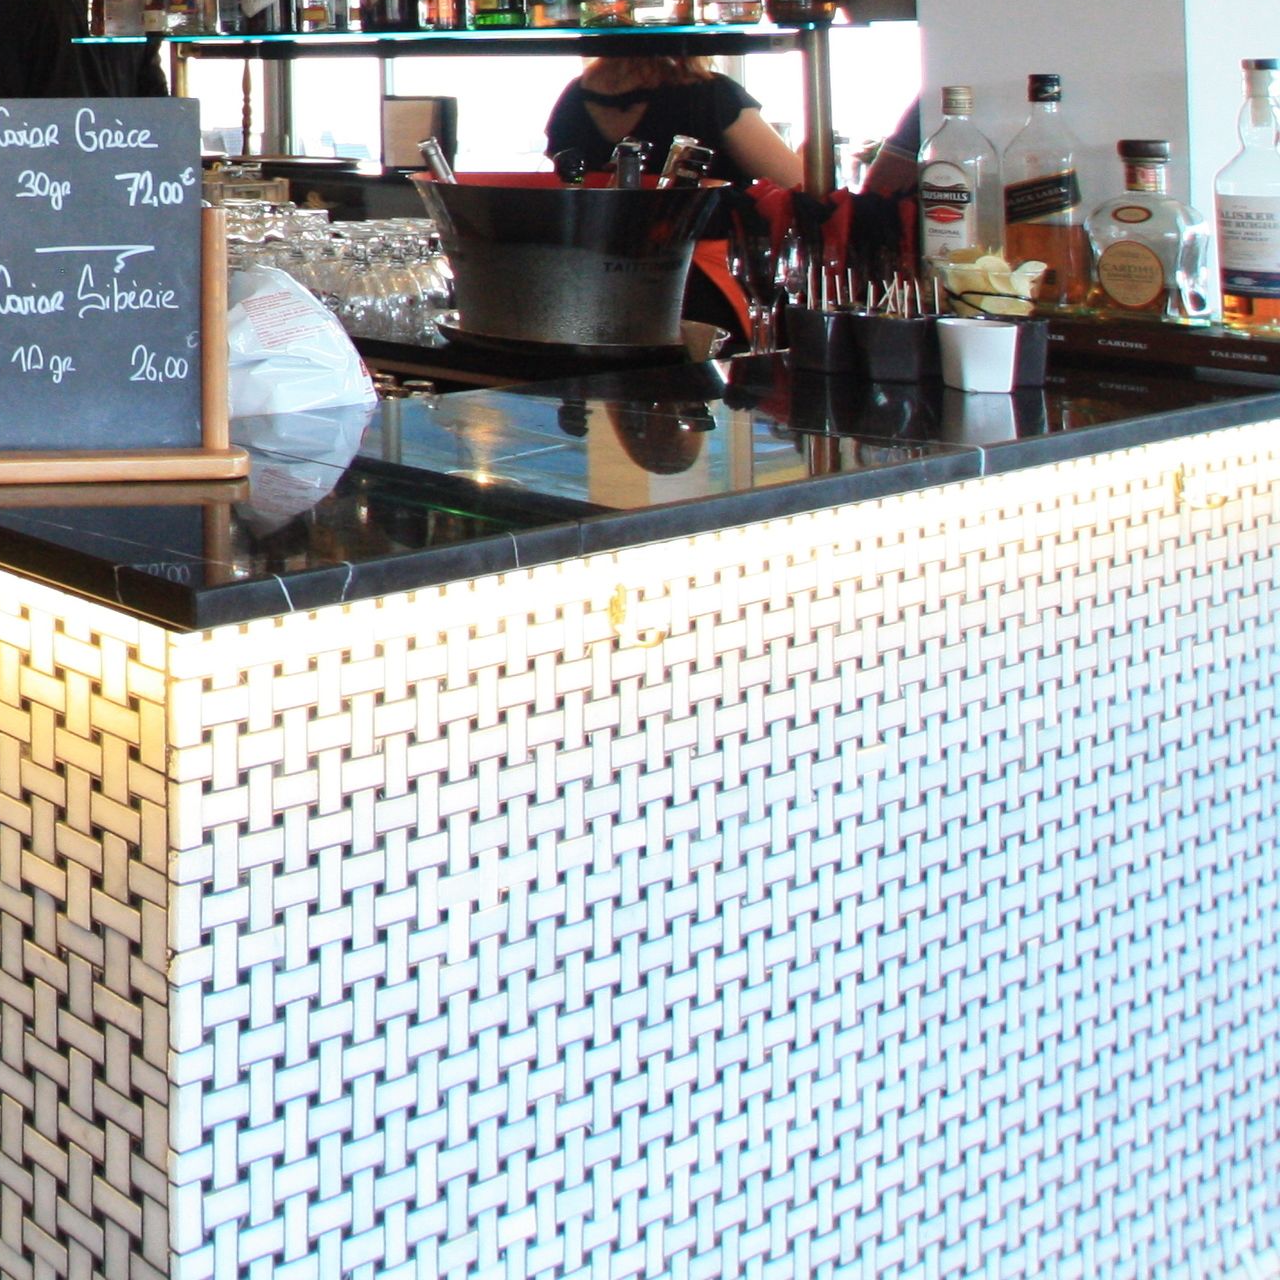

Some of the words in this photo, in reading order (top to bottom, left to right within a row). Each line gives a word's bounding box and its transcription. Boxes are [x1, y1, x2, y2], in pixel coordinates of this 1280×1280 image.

[75, 107, 159, 153] Grèce
[1219, 210, 1275, 220] ALISKER
[1209, 349, 1270, 363] TALISKER
